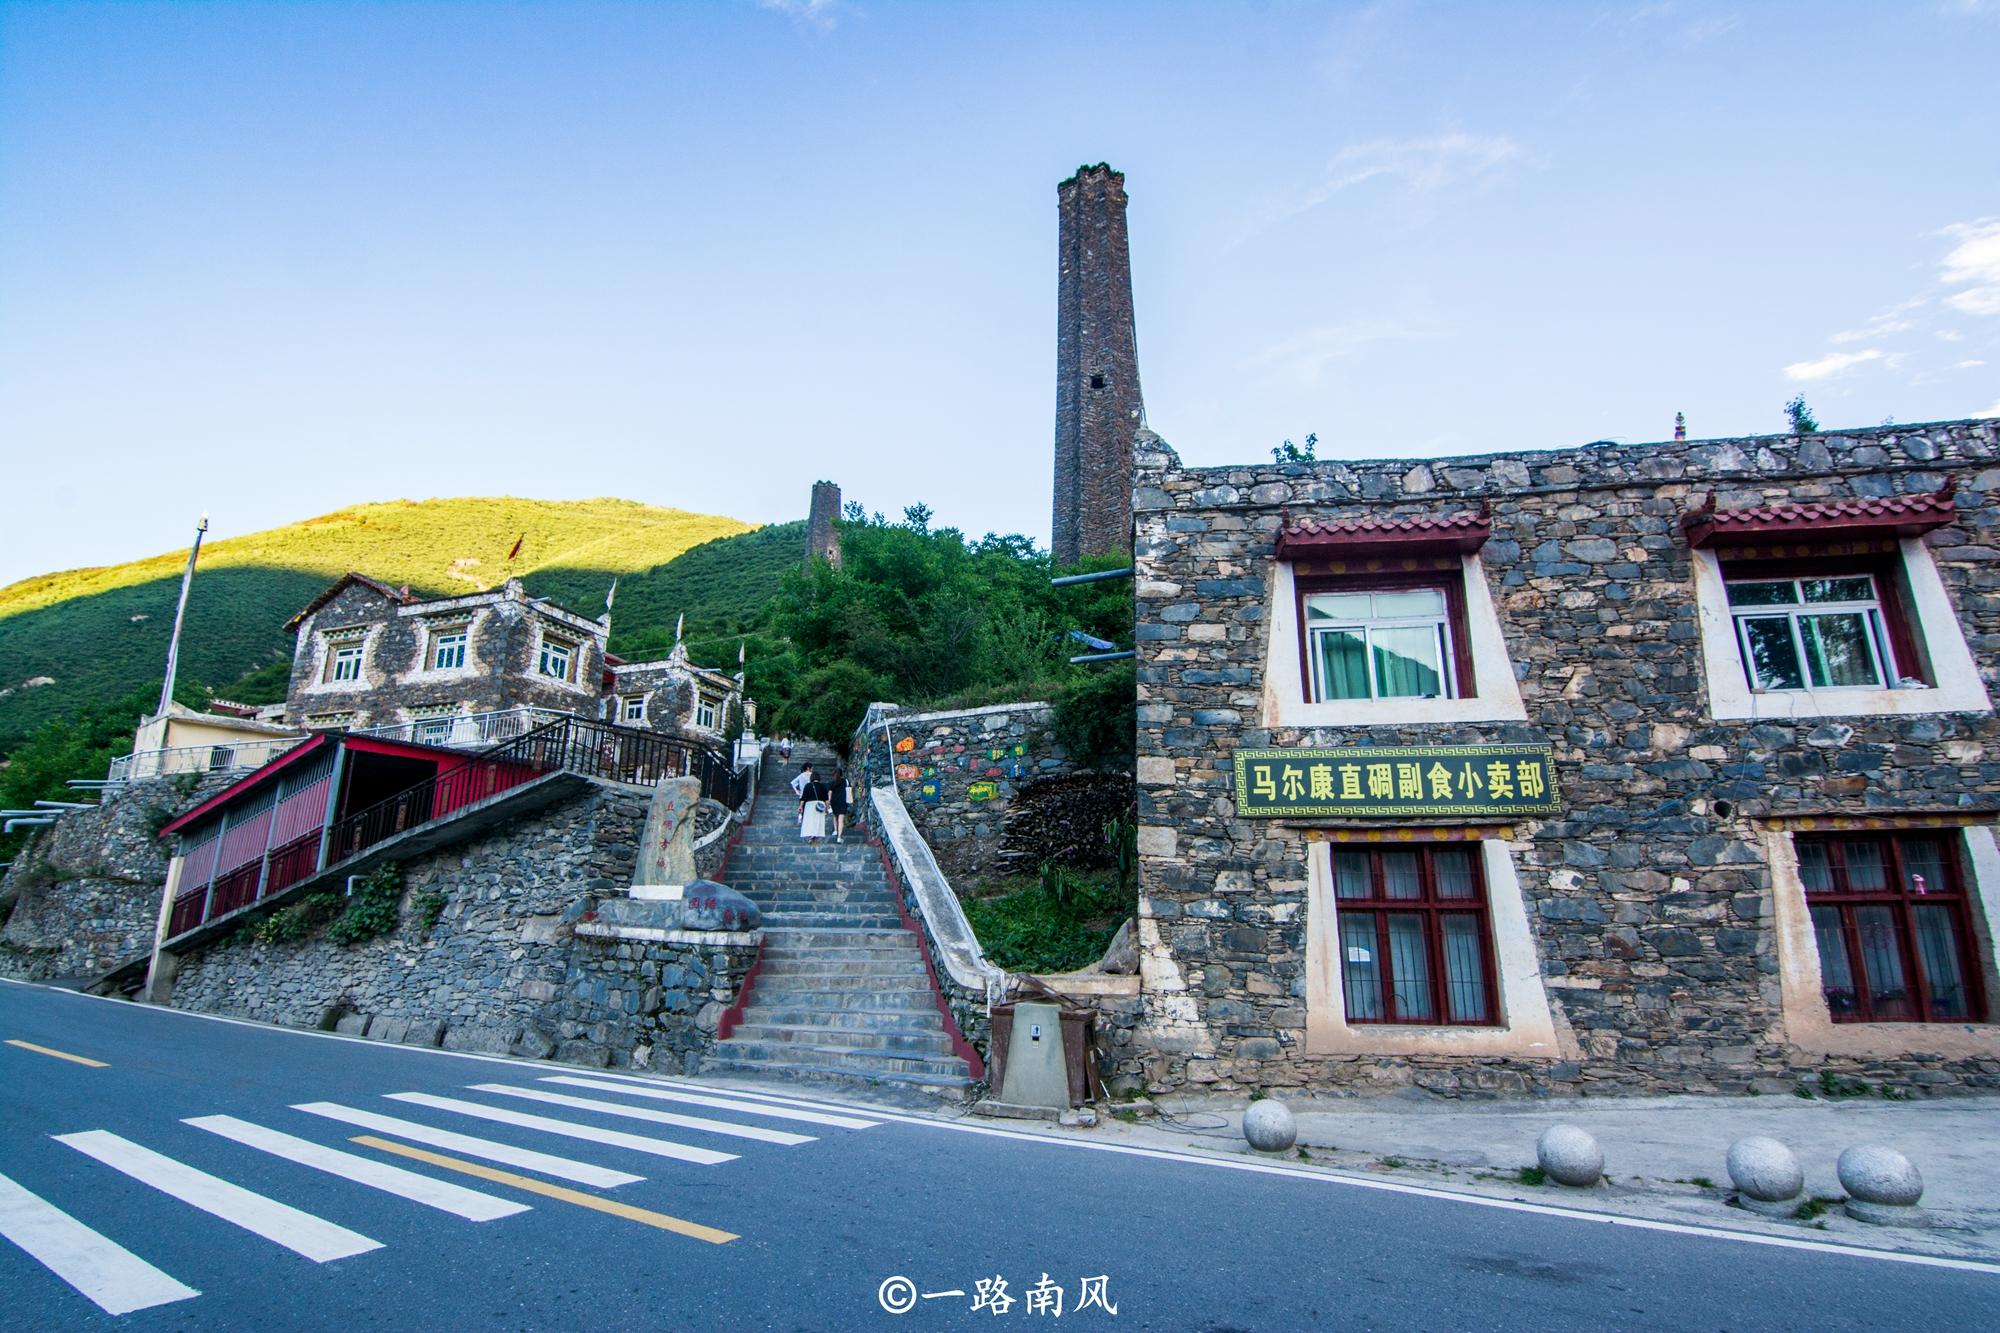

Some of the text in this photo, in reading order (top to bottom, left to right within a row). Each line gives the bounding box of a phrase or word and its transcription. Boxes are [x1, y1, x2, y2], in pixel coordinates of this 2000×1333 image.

[1253, 760, 1545, 801] 马尔康直碉副食小卖部
